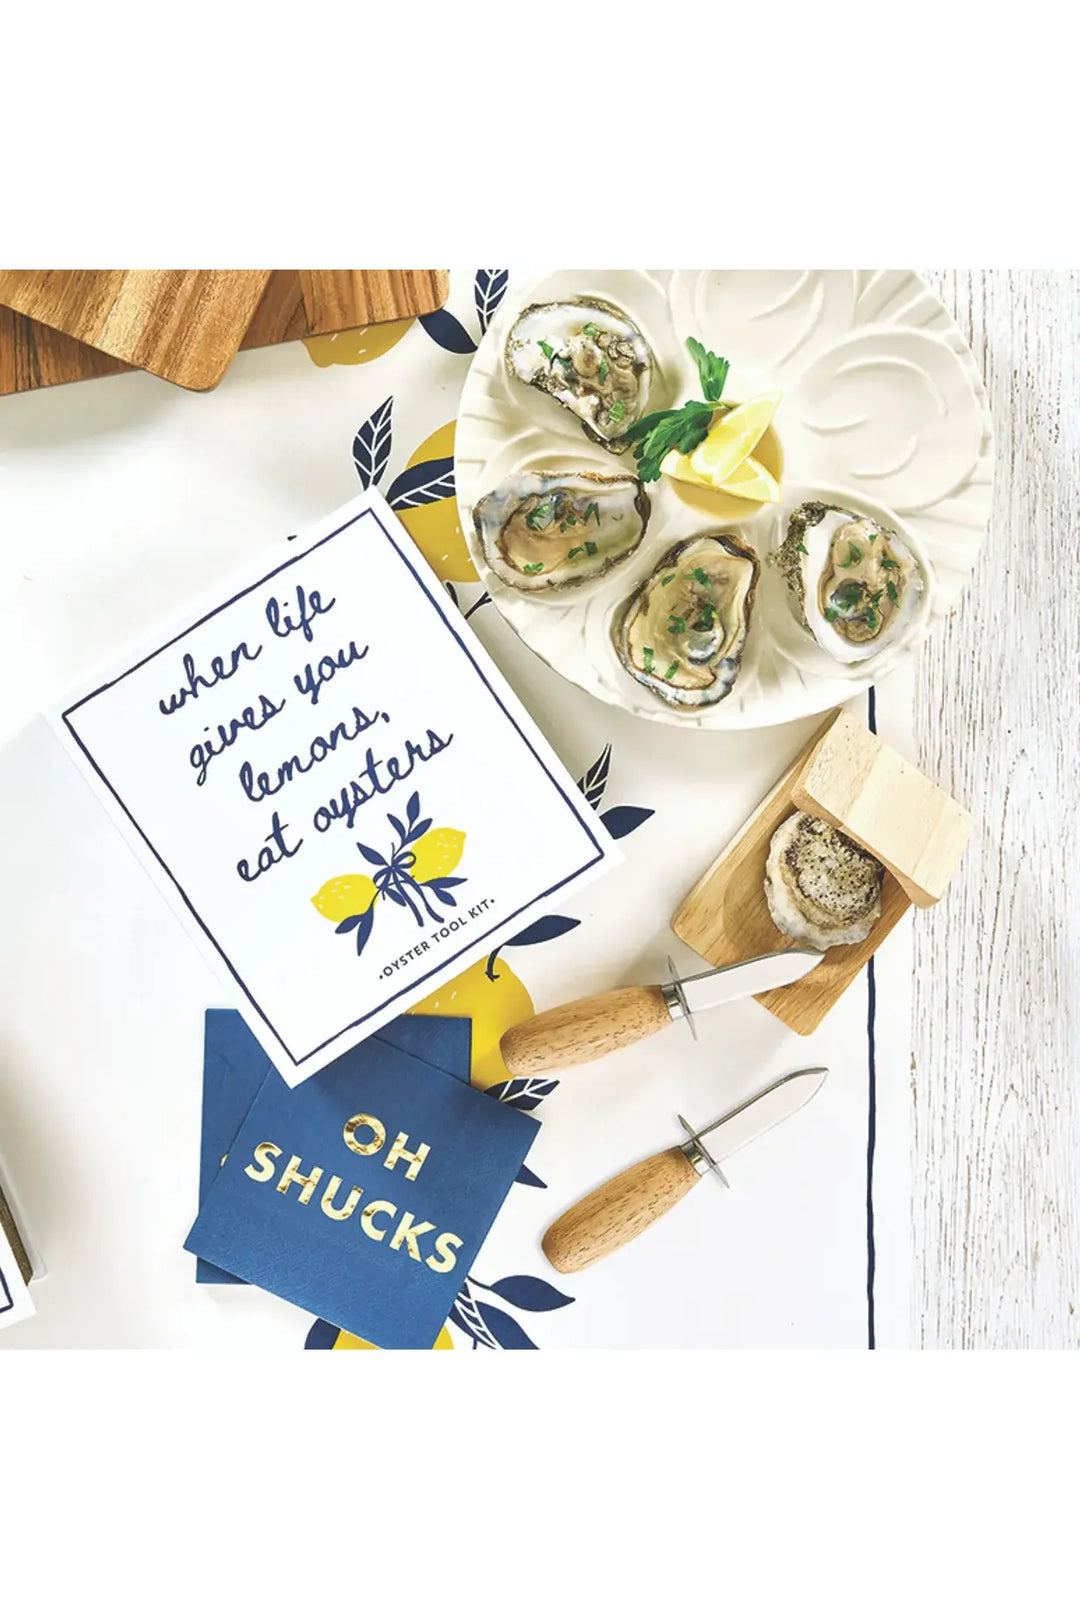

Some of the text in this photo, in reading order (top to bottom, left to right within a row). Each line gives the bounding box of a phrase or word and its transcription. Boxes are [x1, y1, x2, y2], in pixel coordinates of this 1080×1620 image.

[160, 586, 336, 716] when life
[189, 642, 370, 787] gives you
[236, 730, 454, 882] eat oysters
[238, 706, 390, 803] lemons,
[431, 917, 468, 943] TOOL
[244, 1141, 464, 1273] SHUCKS
[342, 1112, 431, 1181] OH
